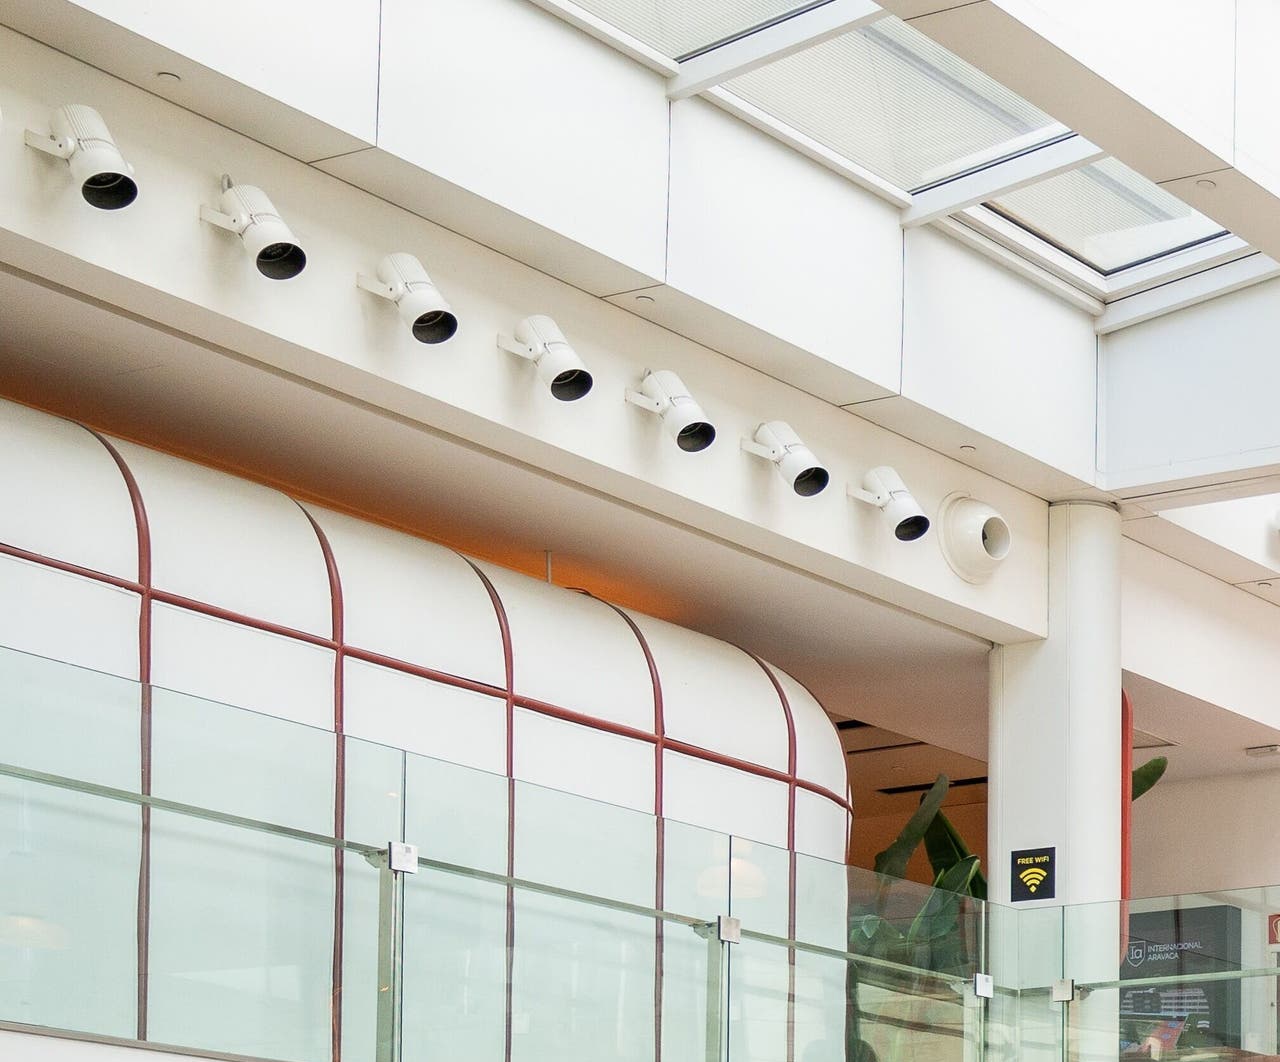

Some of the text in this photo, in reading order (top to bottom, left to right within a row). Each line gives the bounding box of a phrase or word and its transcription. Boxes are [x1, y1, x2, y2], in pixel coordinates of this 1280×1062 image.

[1017, 857, 1034, 865] FREE
[1147, 941, 1203, 953] INTERNACIONAL
[1147, 952, 1180, 961] ARAVACA
